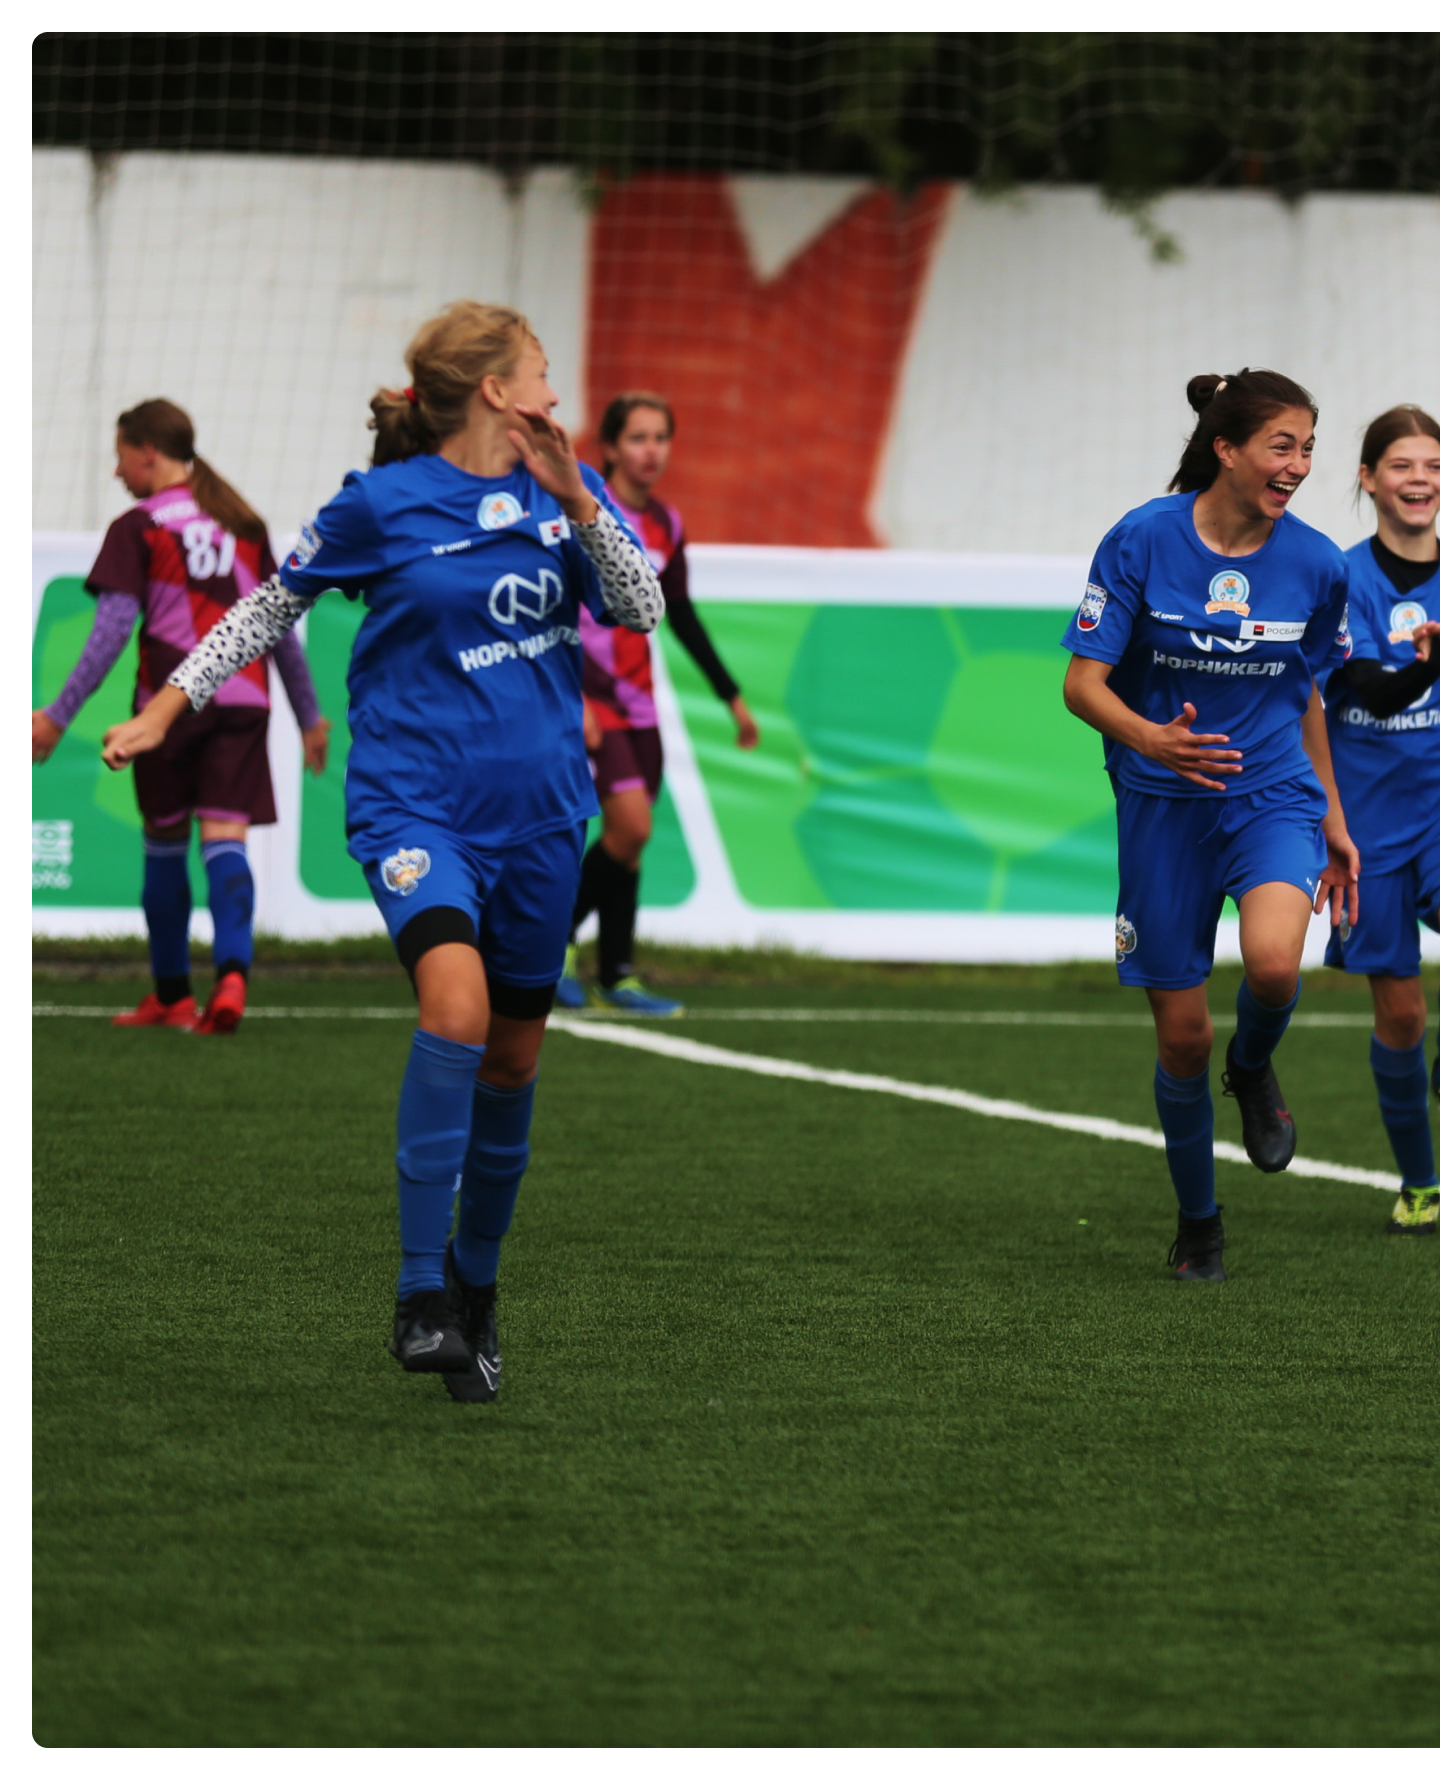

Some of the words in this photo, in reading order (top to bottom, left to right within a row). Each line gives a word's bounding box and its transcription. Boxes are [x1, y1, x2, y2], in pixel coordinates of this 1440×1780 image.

[1161, 612, 1185, 621] SPORT
[1265, 626, 1305, 635] РОСБАНК
[1153, 650, 1287, 677] НОРНИКЕЛЬ
